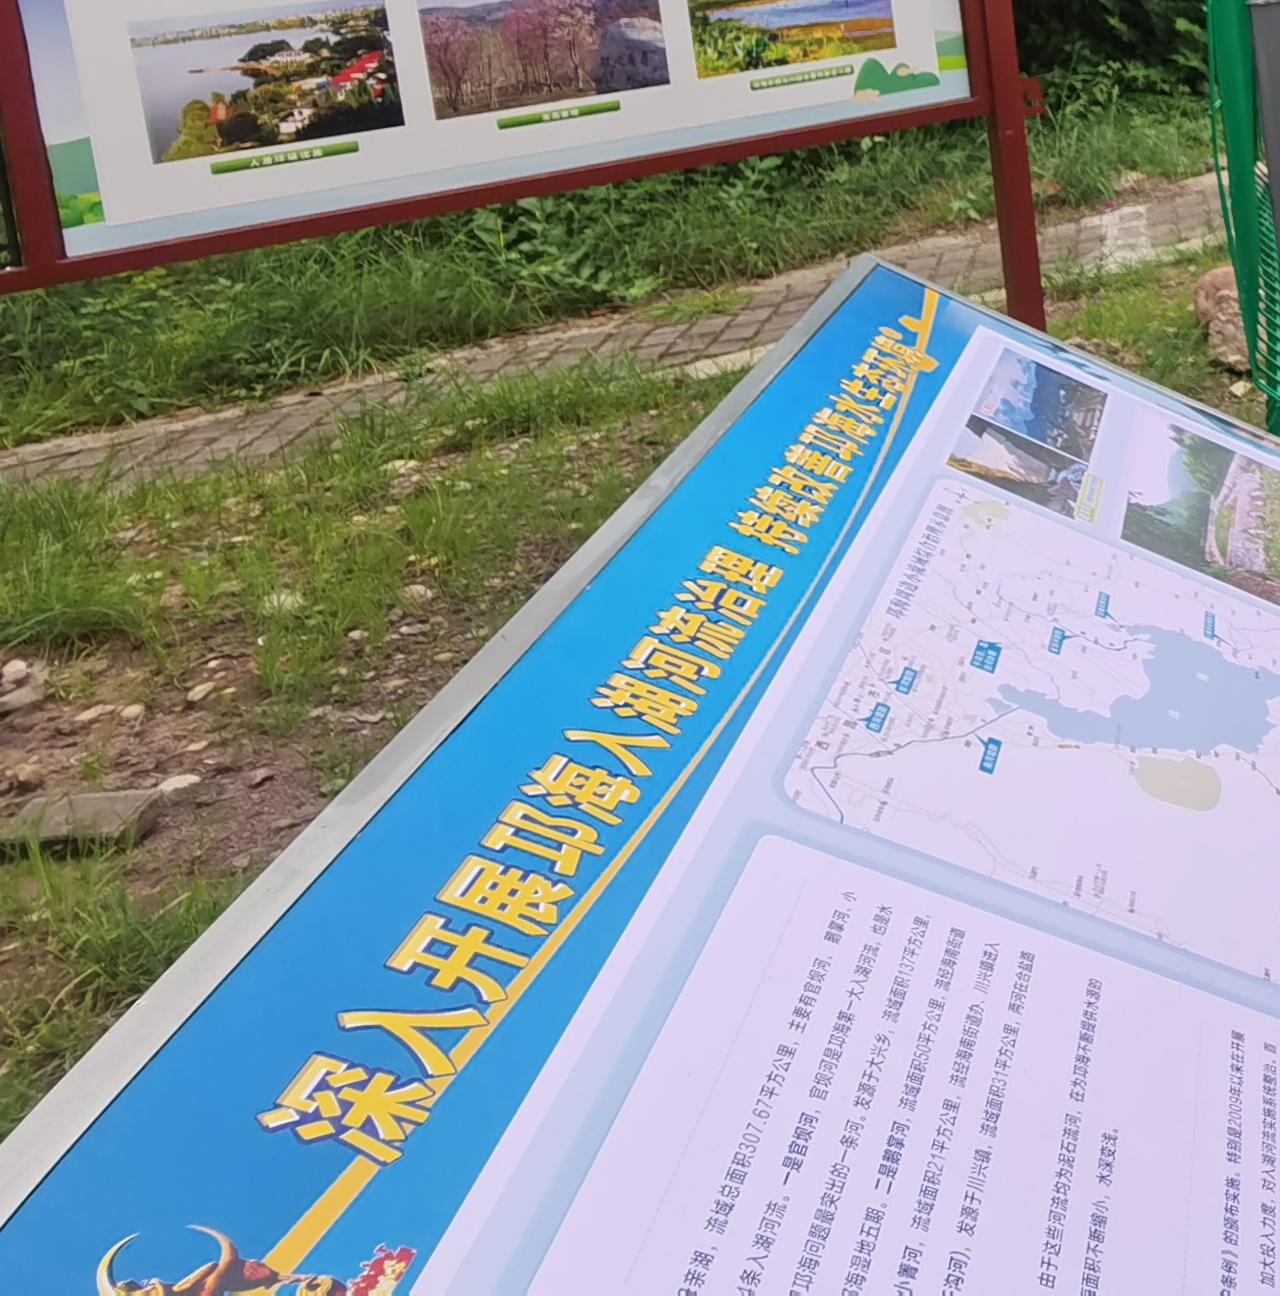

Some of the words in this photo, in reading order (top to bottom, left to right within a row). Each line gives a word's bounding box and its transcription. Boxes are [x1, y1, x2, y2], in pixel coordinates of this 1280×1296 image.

[254, 542, 788, 1166] 深入开展邛海入湖河流治理
[737, 334, 923, 556] 持续改善邛海水生态环境
[1036, 978, 1104, 1289] 由于这些河流均为泥石流河，在为邛海不断提供水源的
